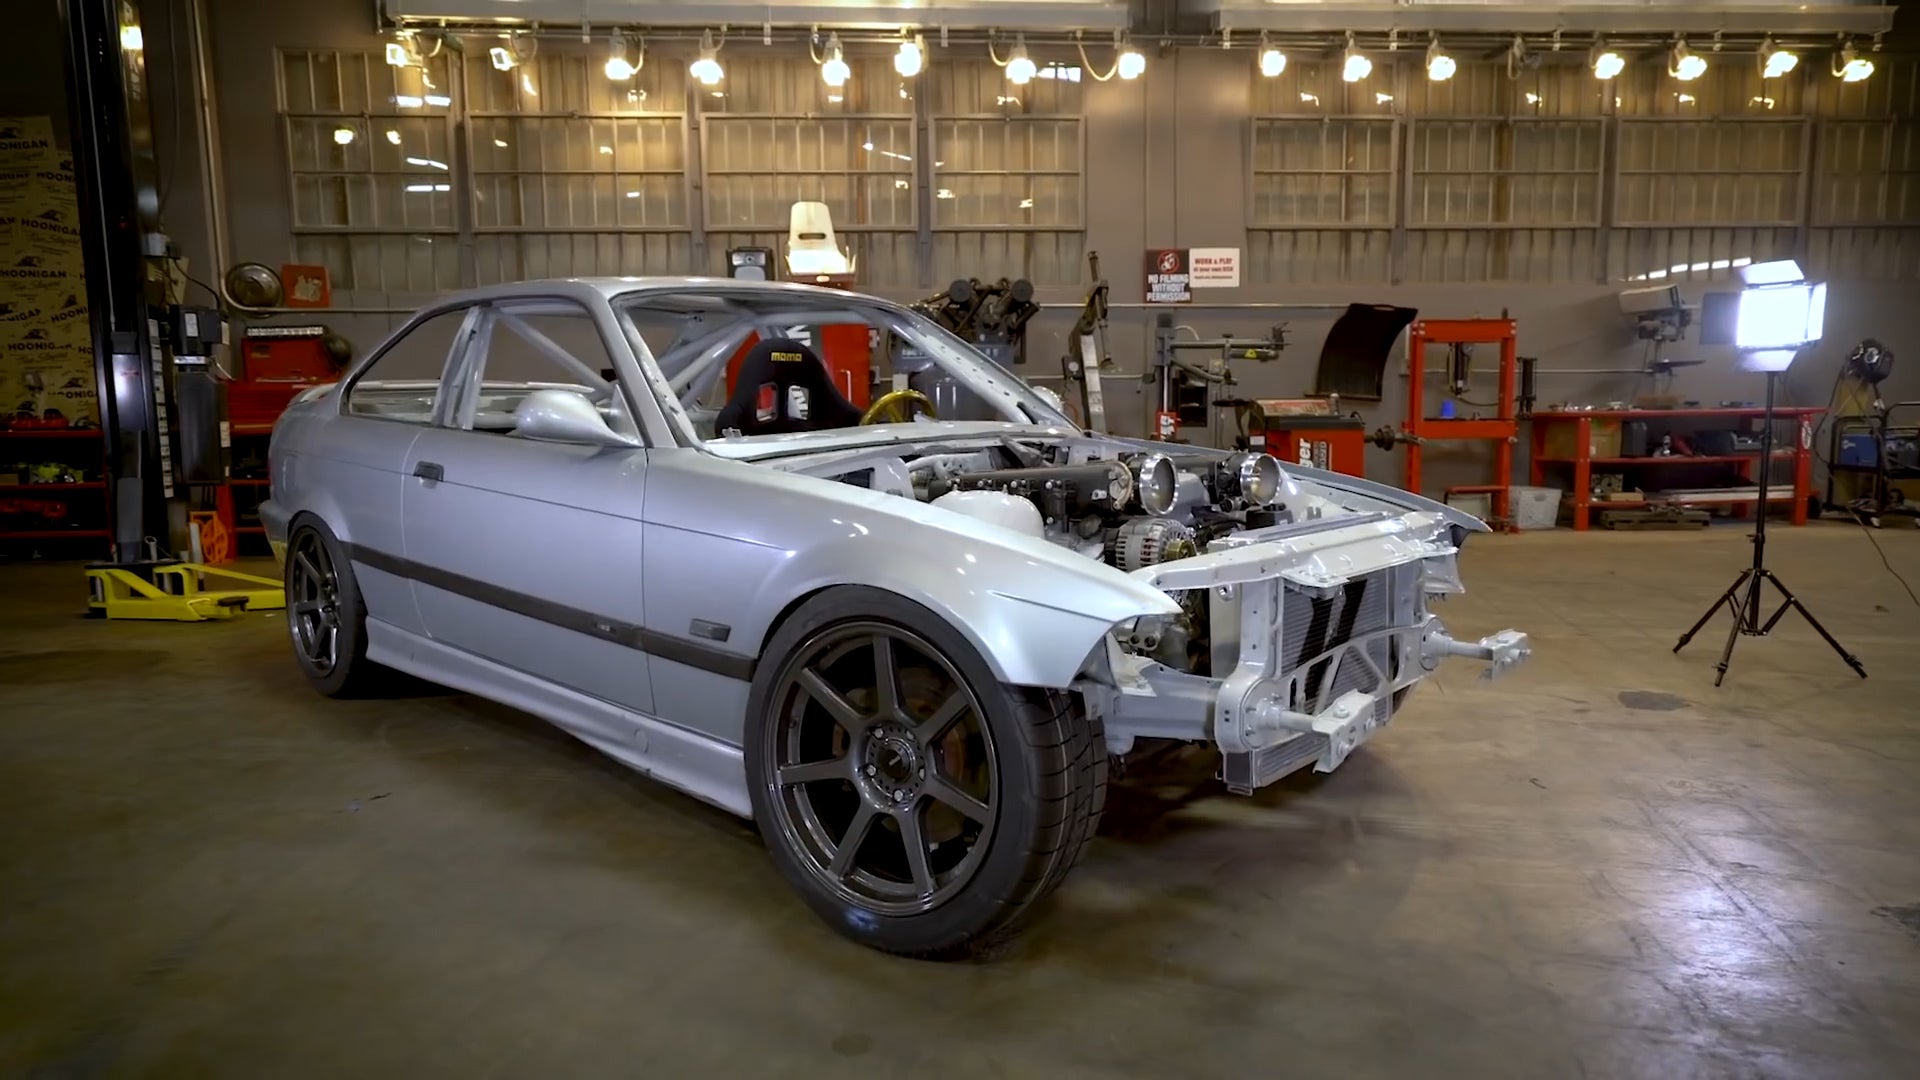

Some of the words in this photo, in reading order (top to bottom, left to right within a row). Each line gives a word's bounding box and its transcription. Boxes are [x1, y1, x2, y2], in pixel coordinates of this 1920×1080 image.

[21, 218, 80, 235] HOONIGA
[0, 270, 67, 278] HOONIGAN
[1148, 274, 1158, 284] NO
[1159, 273, 1189, 284] FILMING
[1152, 283, 1185, 293] WITHOUT
[1146, 292, 1190, 302] PERMISSION
